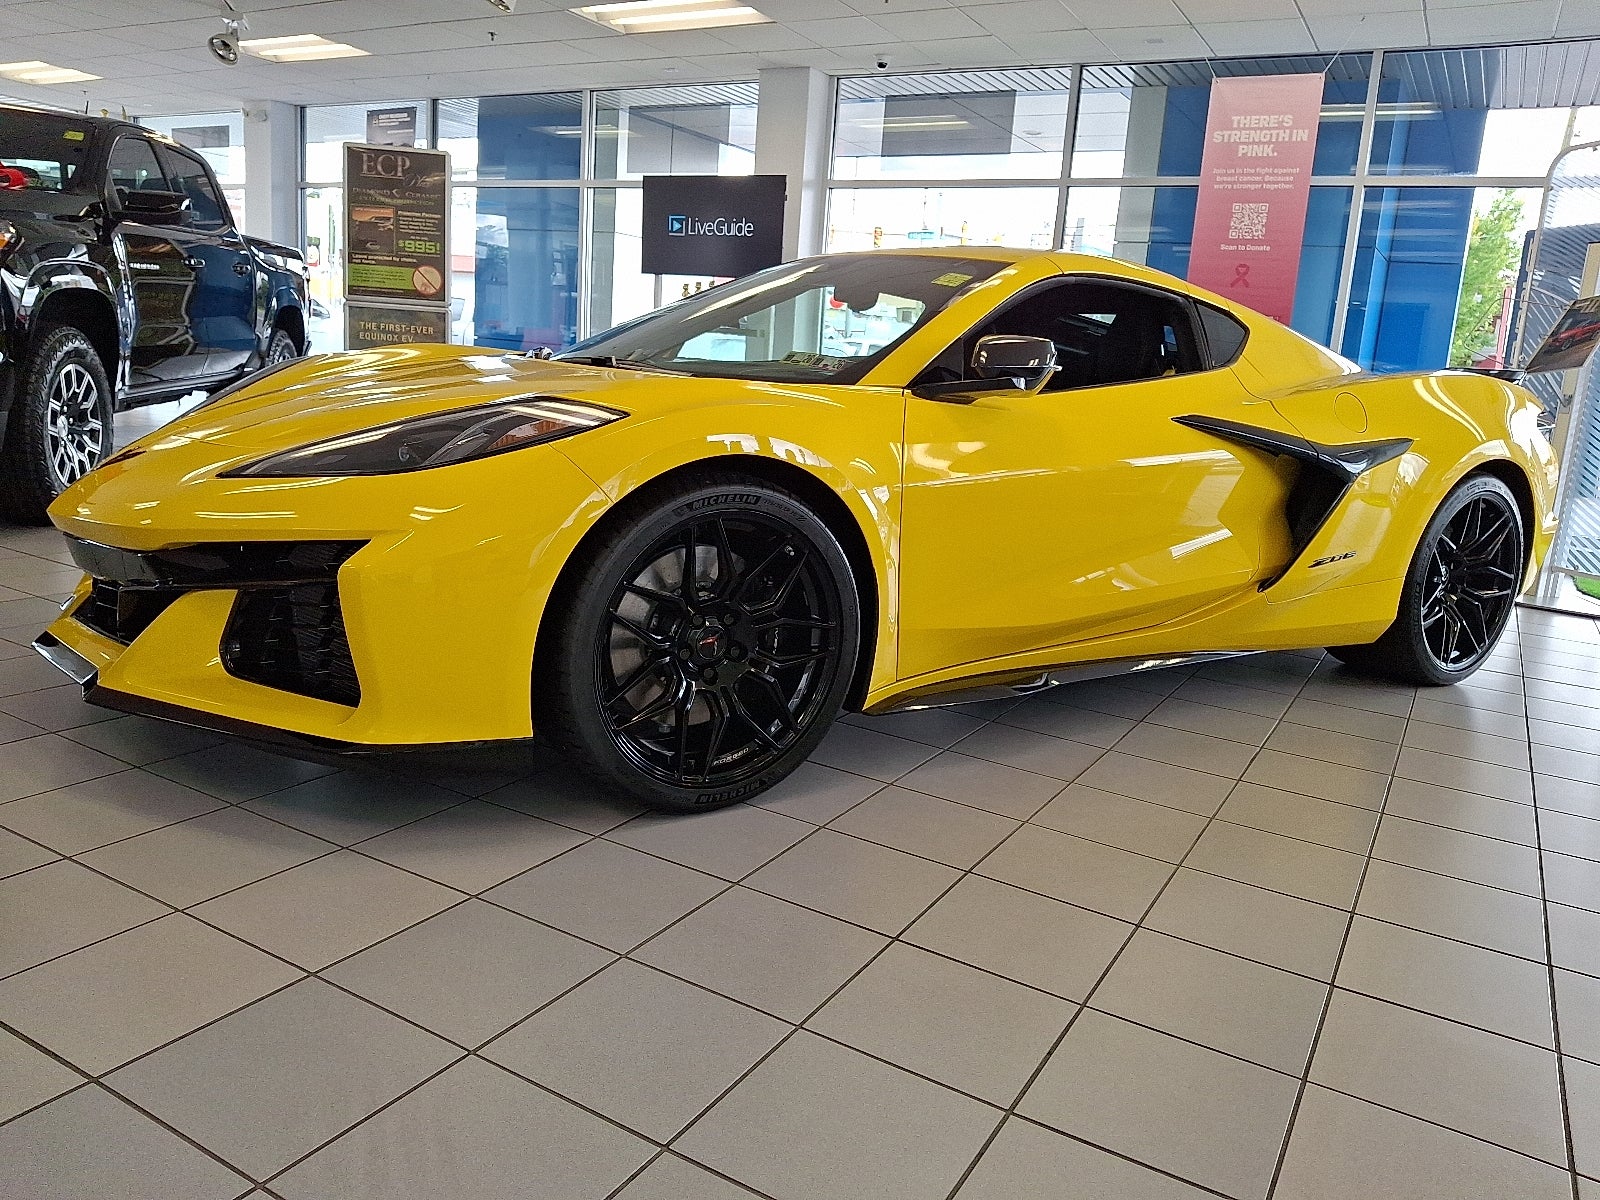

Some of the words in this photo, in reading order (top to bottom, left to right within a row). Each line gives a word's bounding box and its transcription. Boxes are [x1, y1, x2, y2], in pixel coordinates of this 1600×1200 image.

[1213, 129, 1290, 143] STRENGTH
[1291, 129, 1309, 142] IN
[1238, 144, 1277, 157] PINK.
[361, 153, 410, 177] ECP
[1256, 167, 1273, 175] fight
[1273, 167, 1300, 175] against
[688, 217, 754, 237] LiveGuide
[398, 240, 440, 254] $995!
[360, 321, 377, 331] THE
[380, 323, 434, 335] FIRST-EVER
[359, 332, 399, 342] EQUINOX
[401, 334, 416, 343] EV.
[692, 494, 758, 510] MICHELIN
[698, 781, 761, 803] MICHELIN
